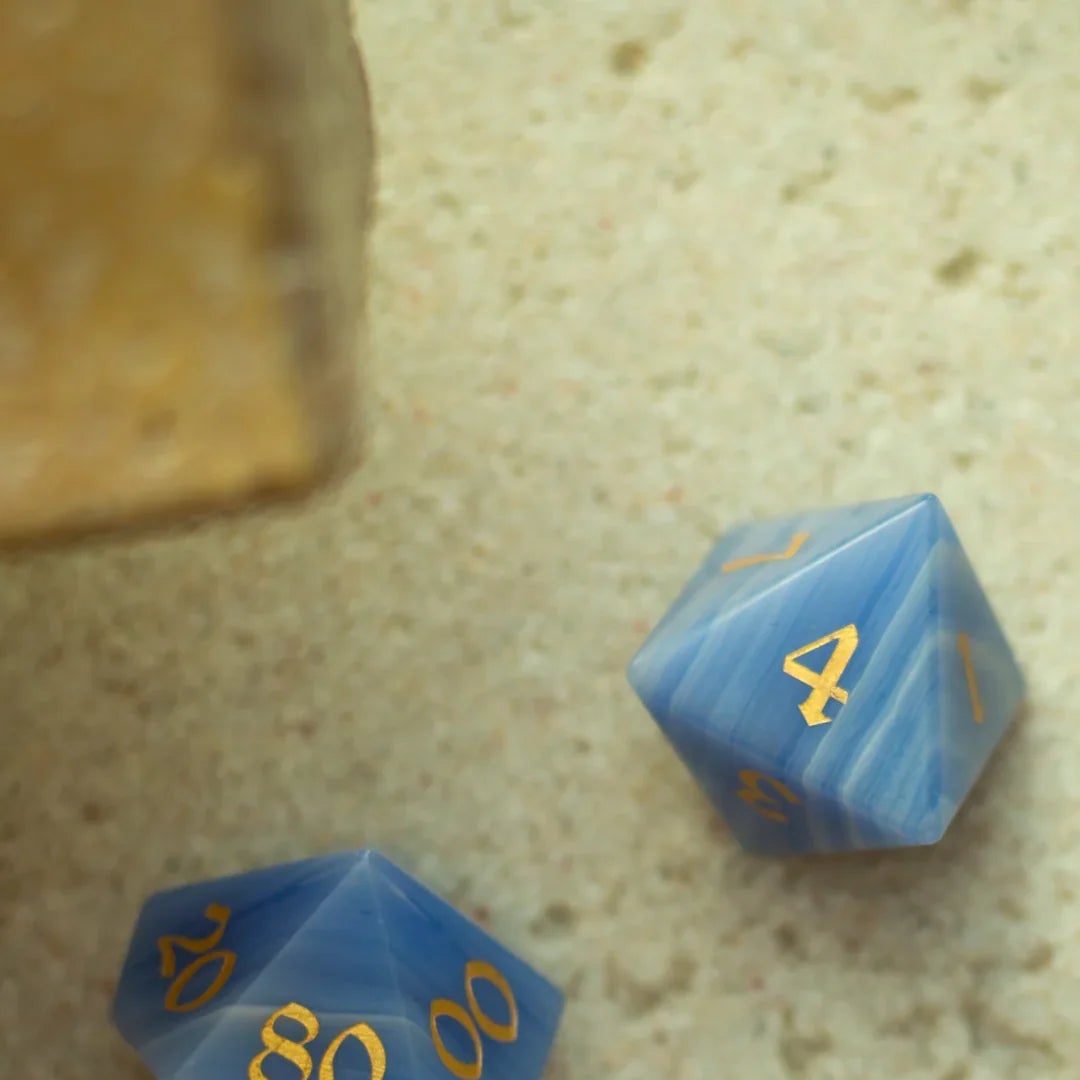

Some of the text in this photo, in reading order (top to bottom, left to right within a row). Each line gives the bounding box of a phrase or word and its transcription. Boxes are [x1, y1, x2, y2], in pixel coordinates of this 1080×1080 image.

[782, 623, 859, 727] 4
[157, 903, 238, 1013] 20
[429, 960, 519, 1080] 00
